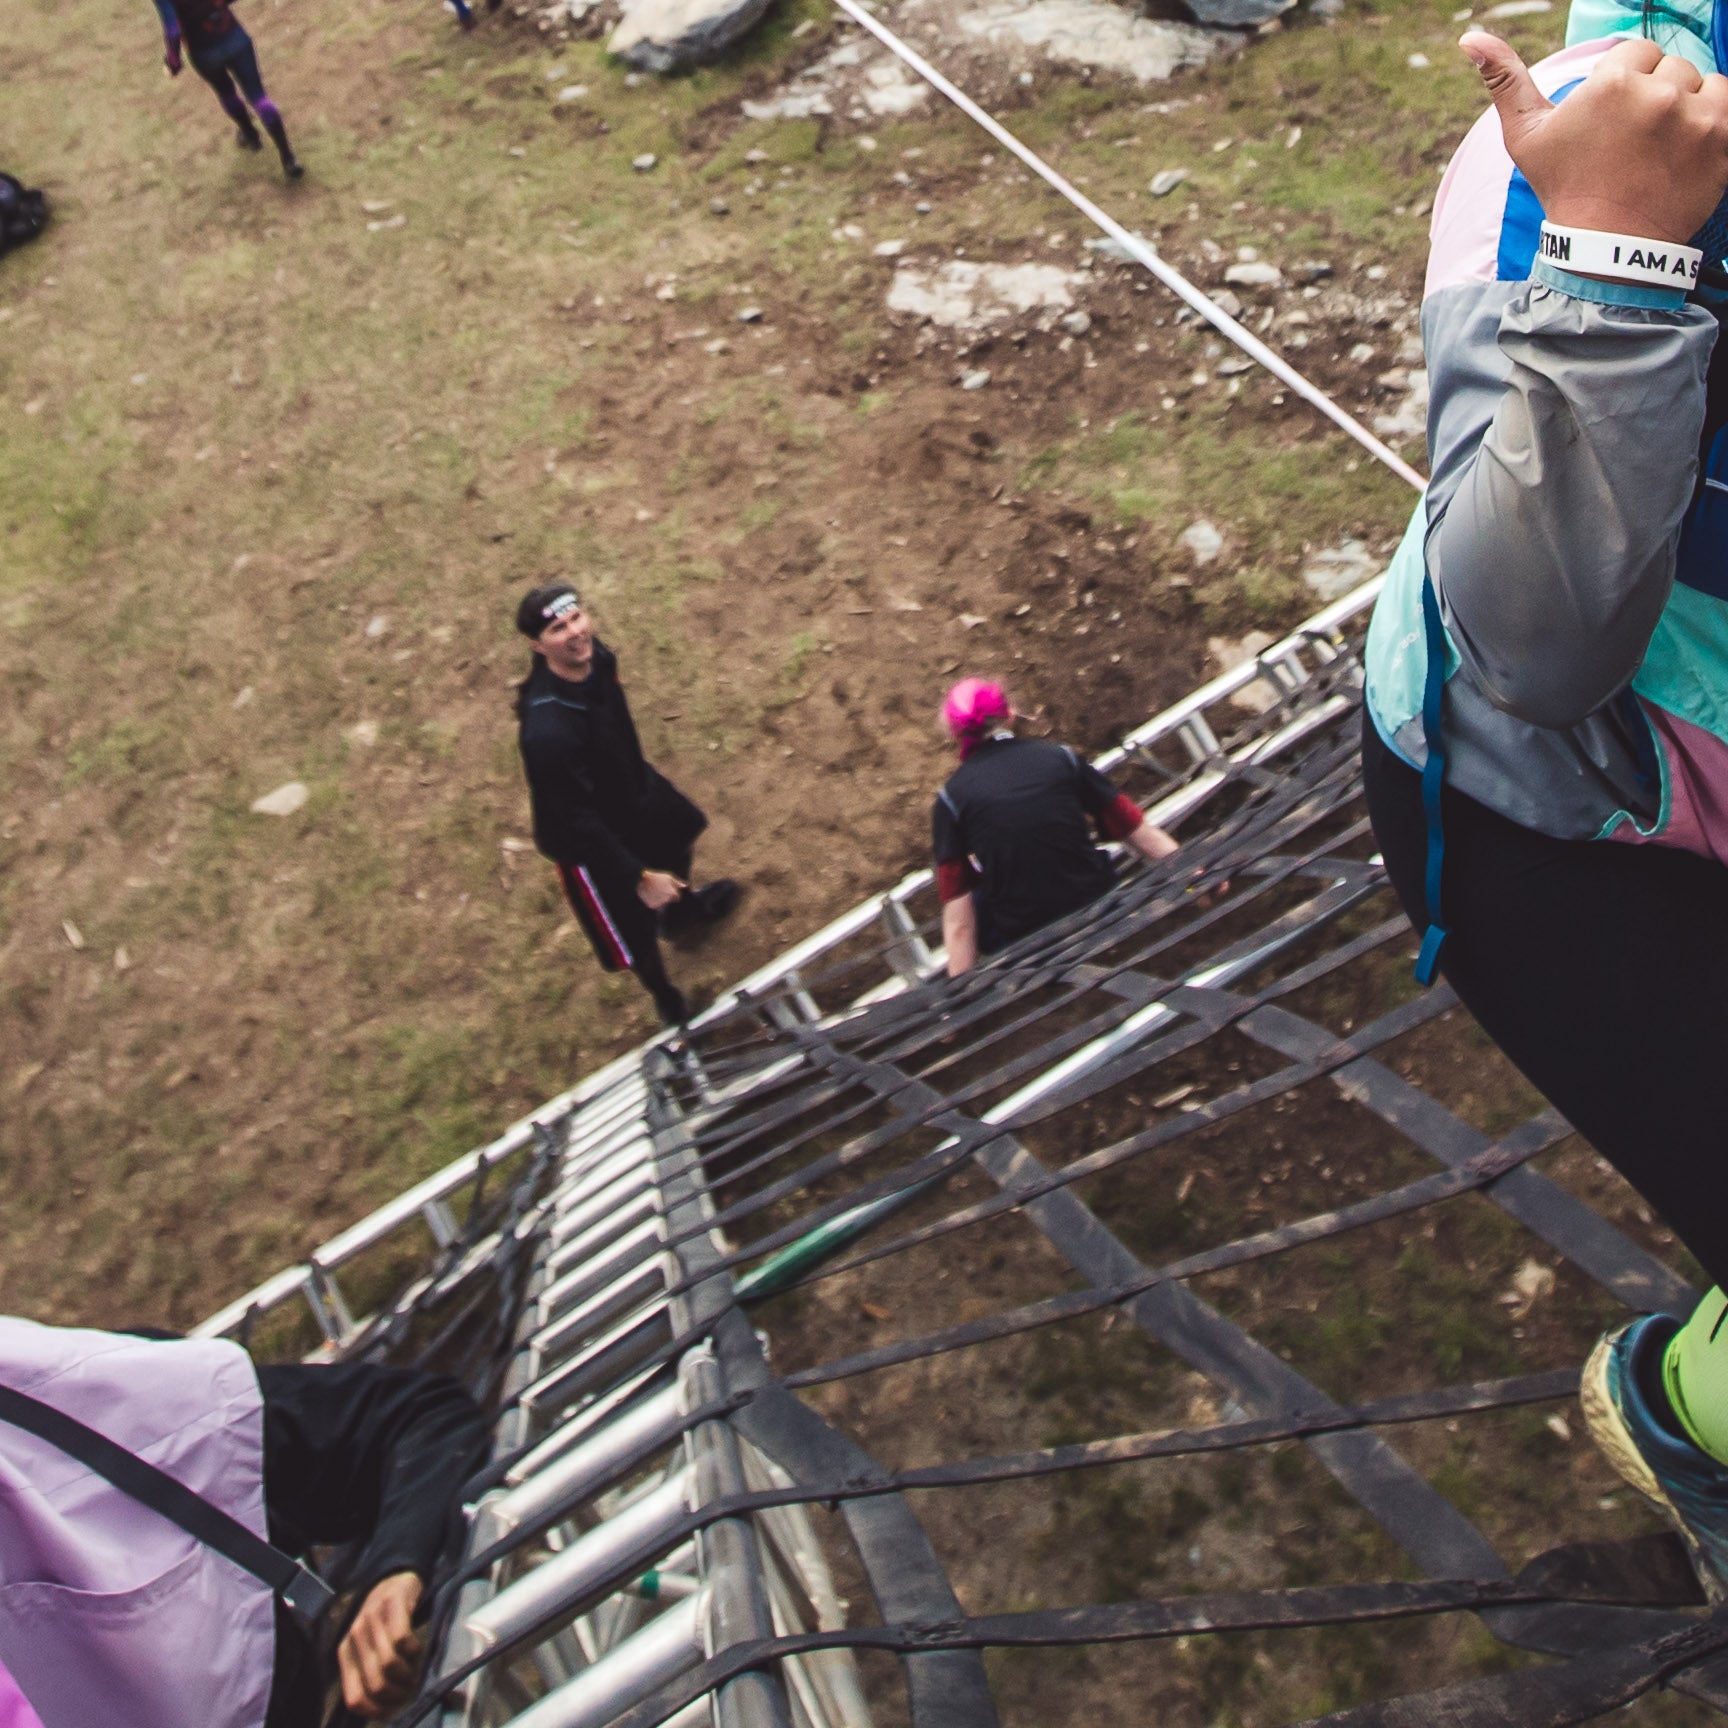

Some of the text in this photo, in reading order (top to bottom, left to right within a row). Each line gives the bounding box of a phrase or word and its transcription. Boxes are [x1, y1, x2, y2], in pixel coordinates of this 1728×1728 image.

[1613, 246, 1621, 264] I
[1627, 249, 1668, 273] AM
[1671, 257, 1686, 277] A
